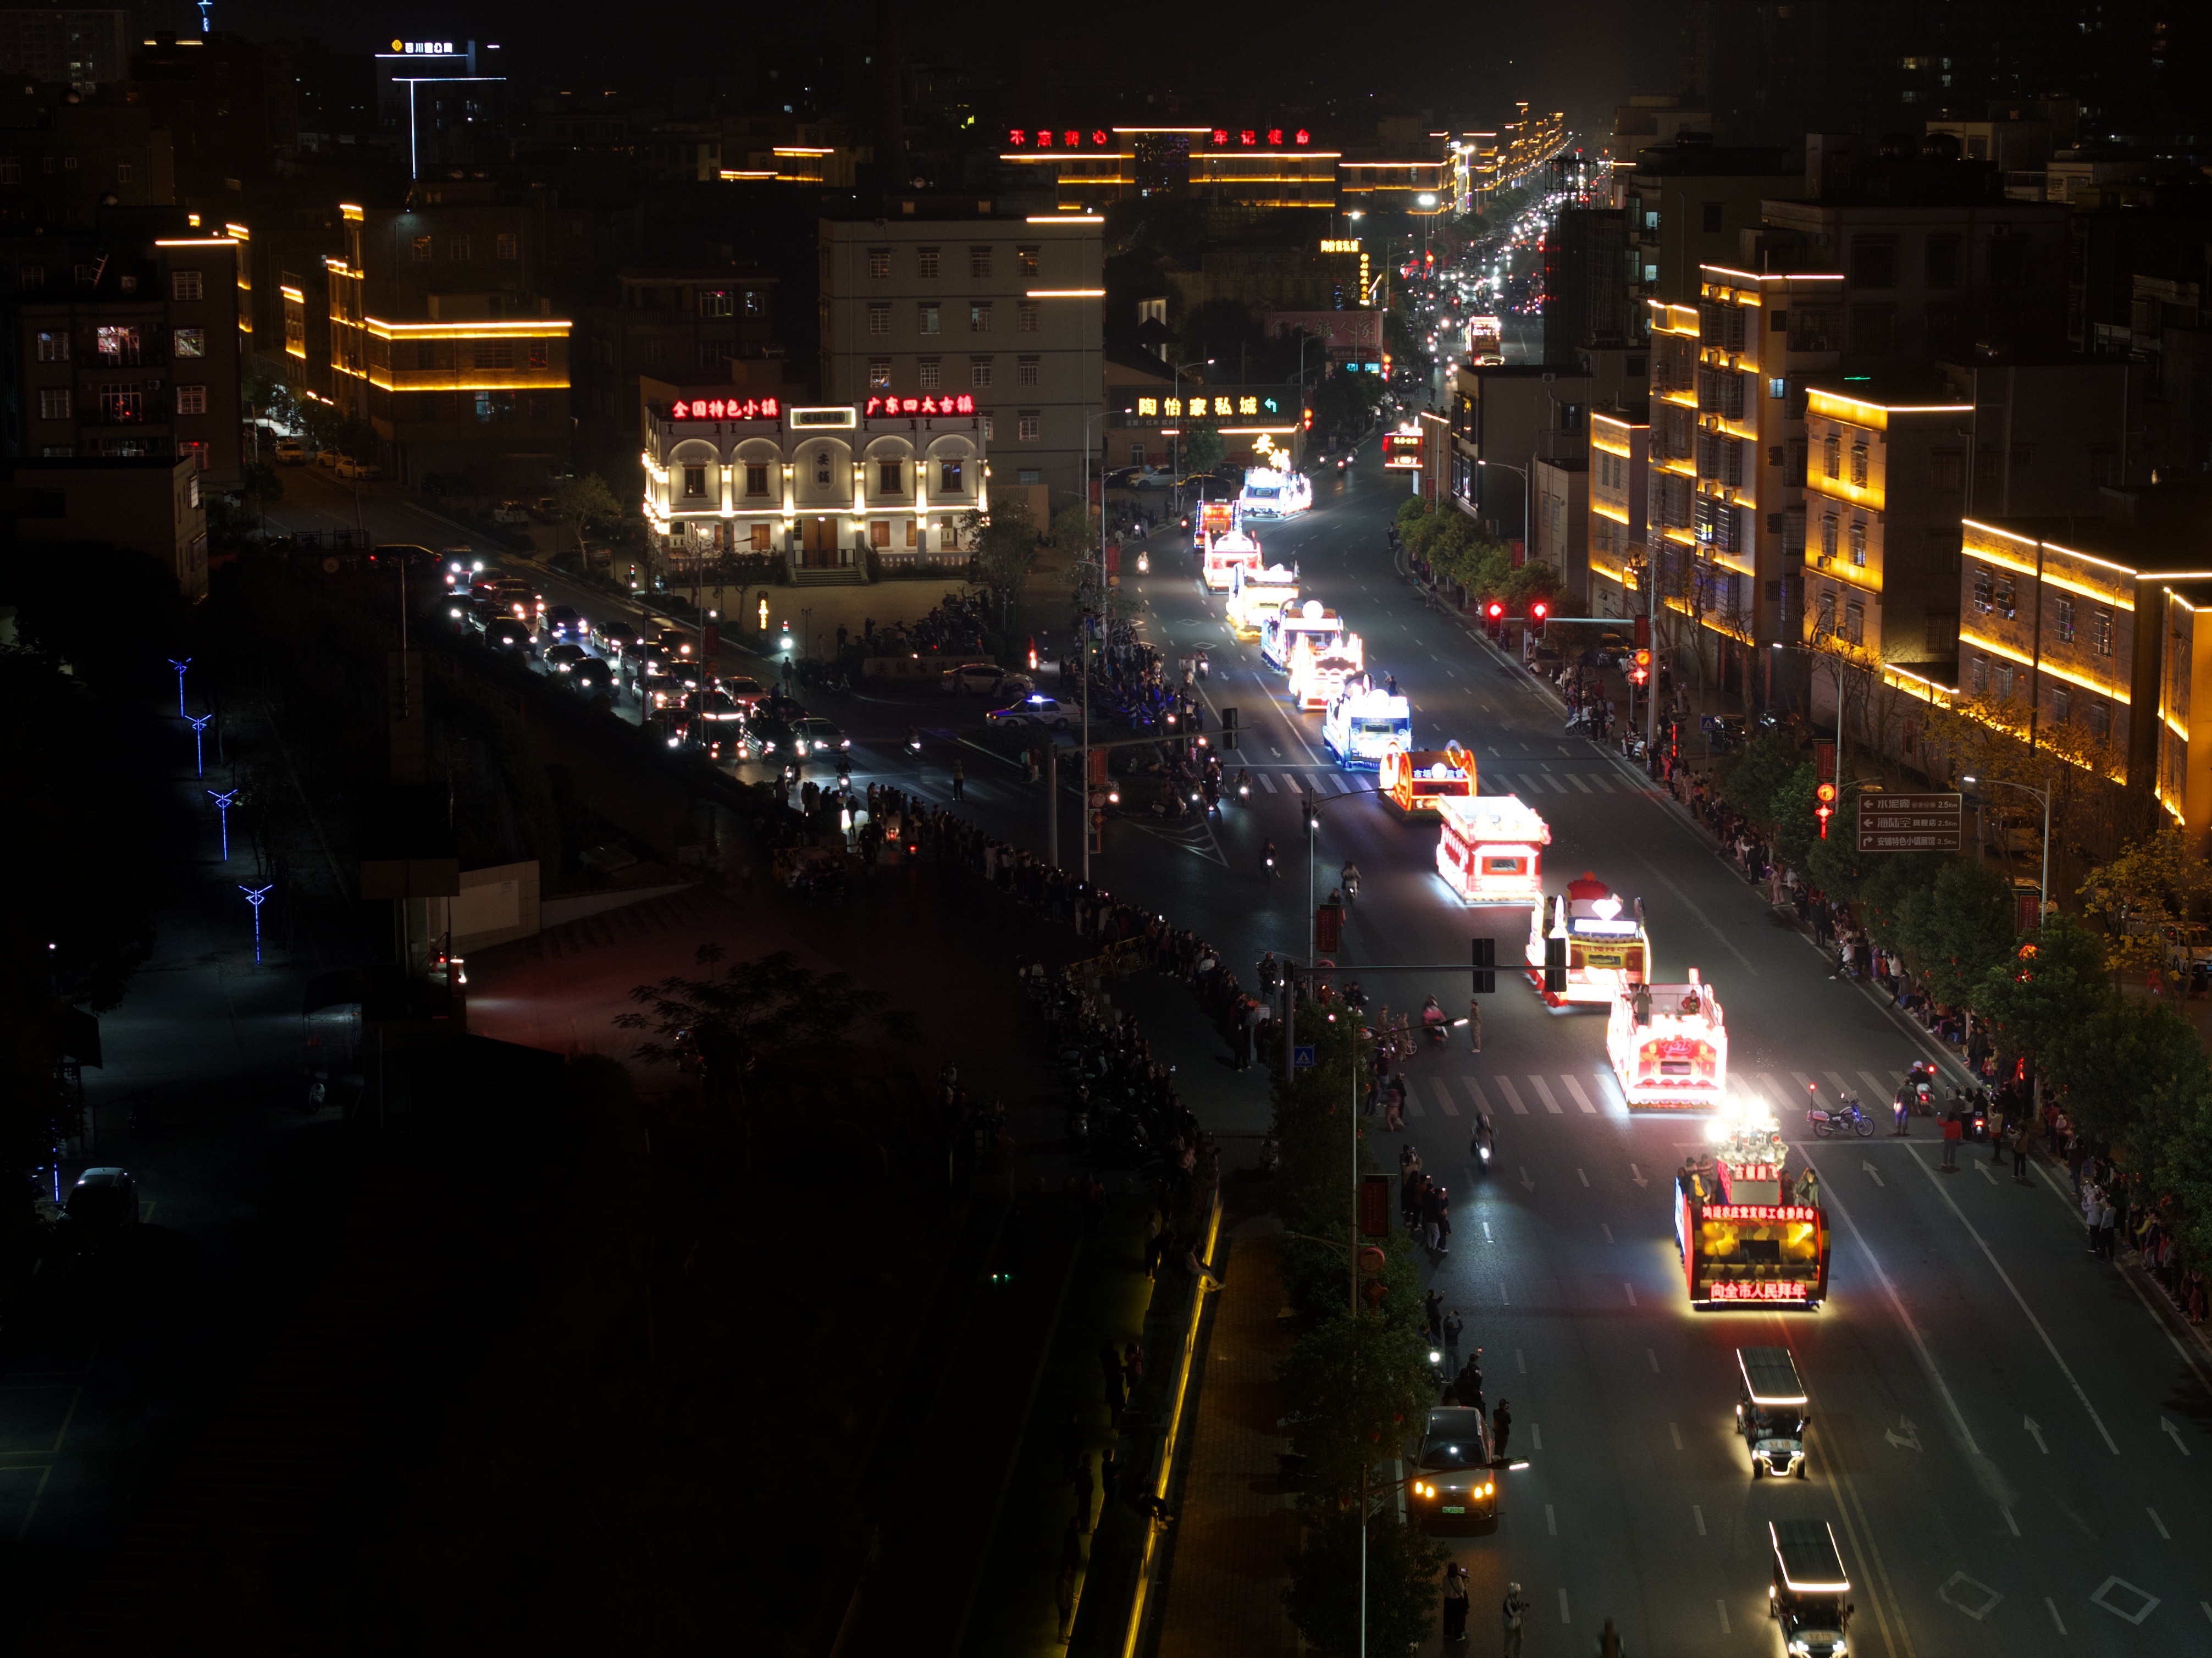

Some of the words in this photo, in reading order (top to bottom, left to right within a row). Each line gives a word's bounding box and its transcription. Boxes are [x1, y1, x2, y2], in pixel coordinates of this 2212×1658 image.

[1010, 129, 1107, 146] 不忘初心
[1213, 129, 1310, 145] 牢记使命
[672, 397, 778, 418] 全国特色小镇
[866, 394, 975, 416] 广东四大古镇
[1138, 396, 1258, 417] 陶怡家私城
[1877, 817, 1911, 828] 海陆空
[1711, 1283, 1807, 1299] 向全市人民拜年
